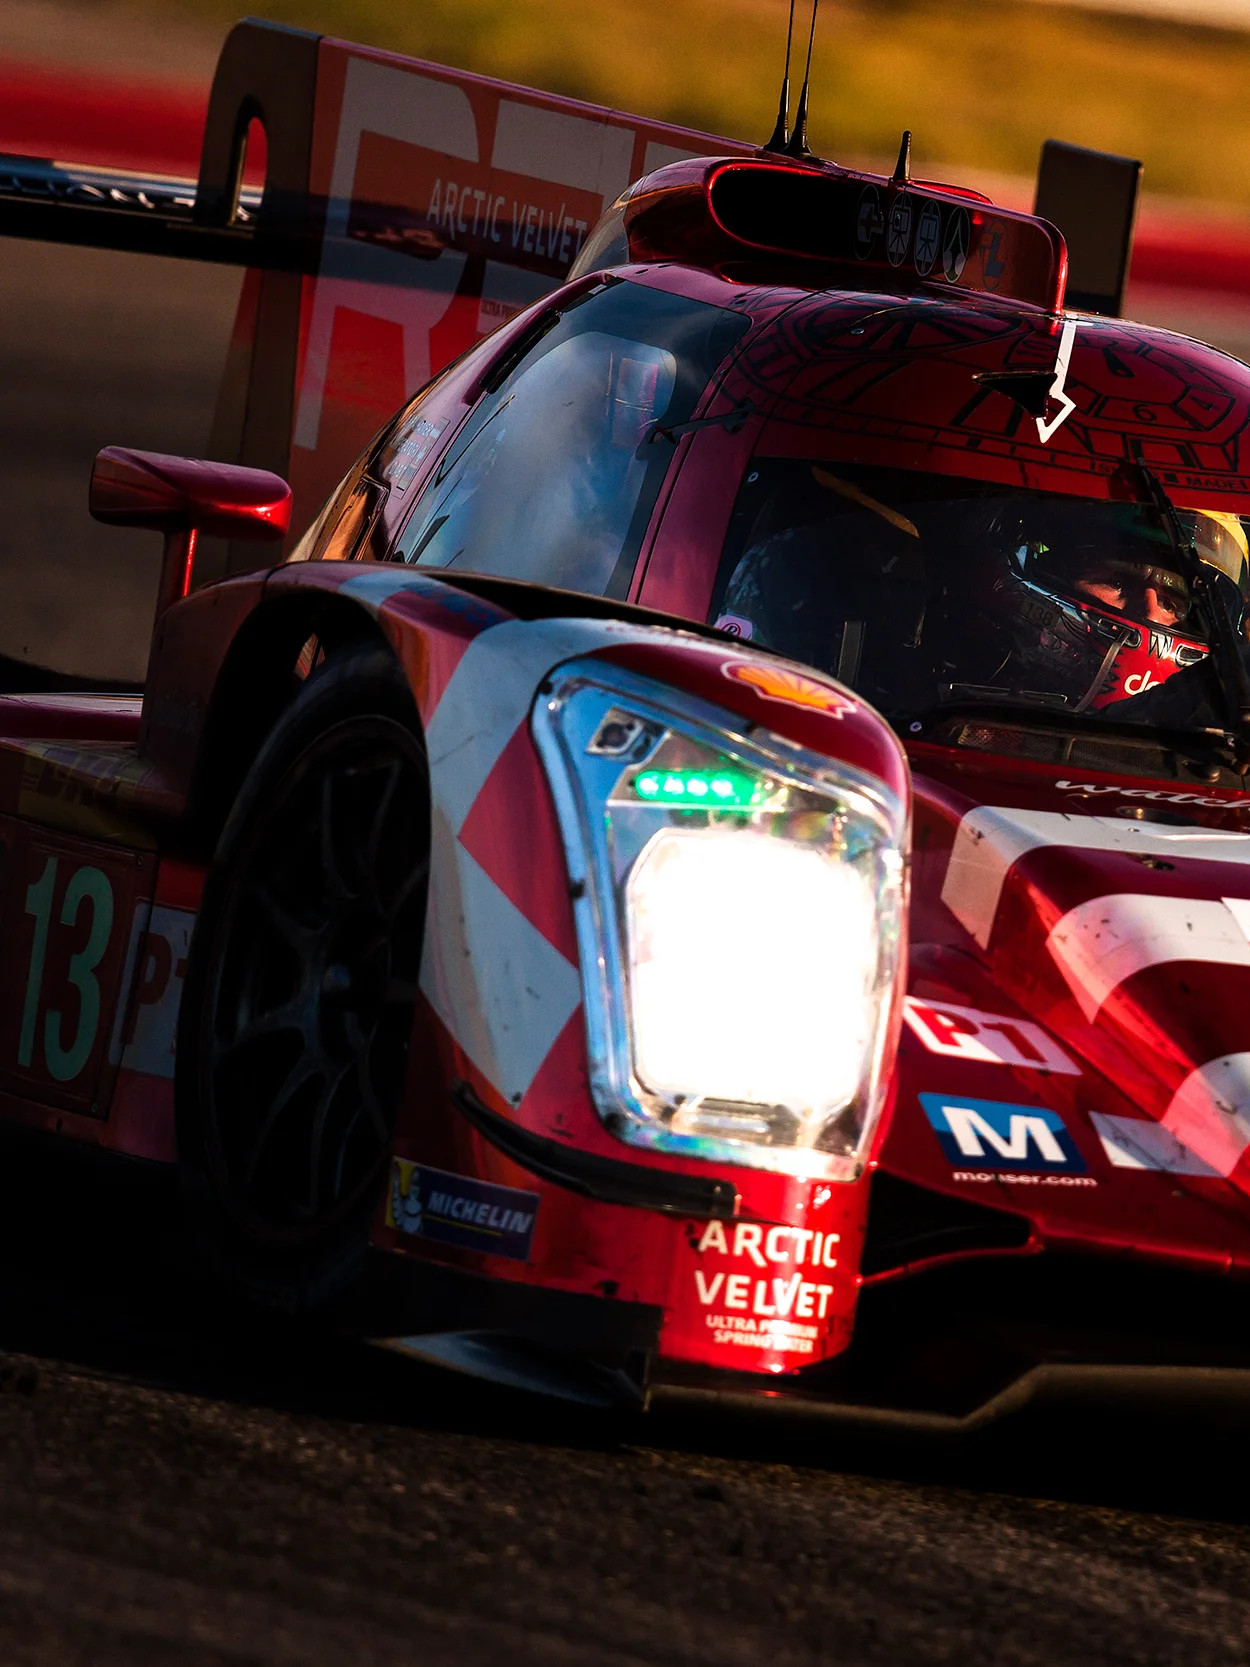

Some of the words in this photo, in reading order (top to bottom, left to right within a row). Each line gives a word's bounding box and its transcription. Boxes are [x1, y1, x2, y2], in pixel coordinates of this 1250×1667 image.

[426, 178, 506, 243] ARCTIC
[511, 201, 588, 263] VELVET
[18, 856, 114, 1082] 13
[908, 1004, 1048, 1064] P1
[941, 1105, 1068, 1163] M
[428, 1190, 534, 1235] MICHELIN
[698, 1219, 841, 1268] ARCTIC
[694, 1269, 834, 1319] VELVET
[706, 1314, 757, 1333] ULTRA
